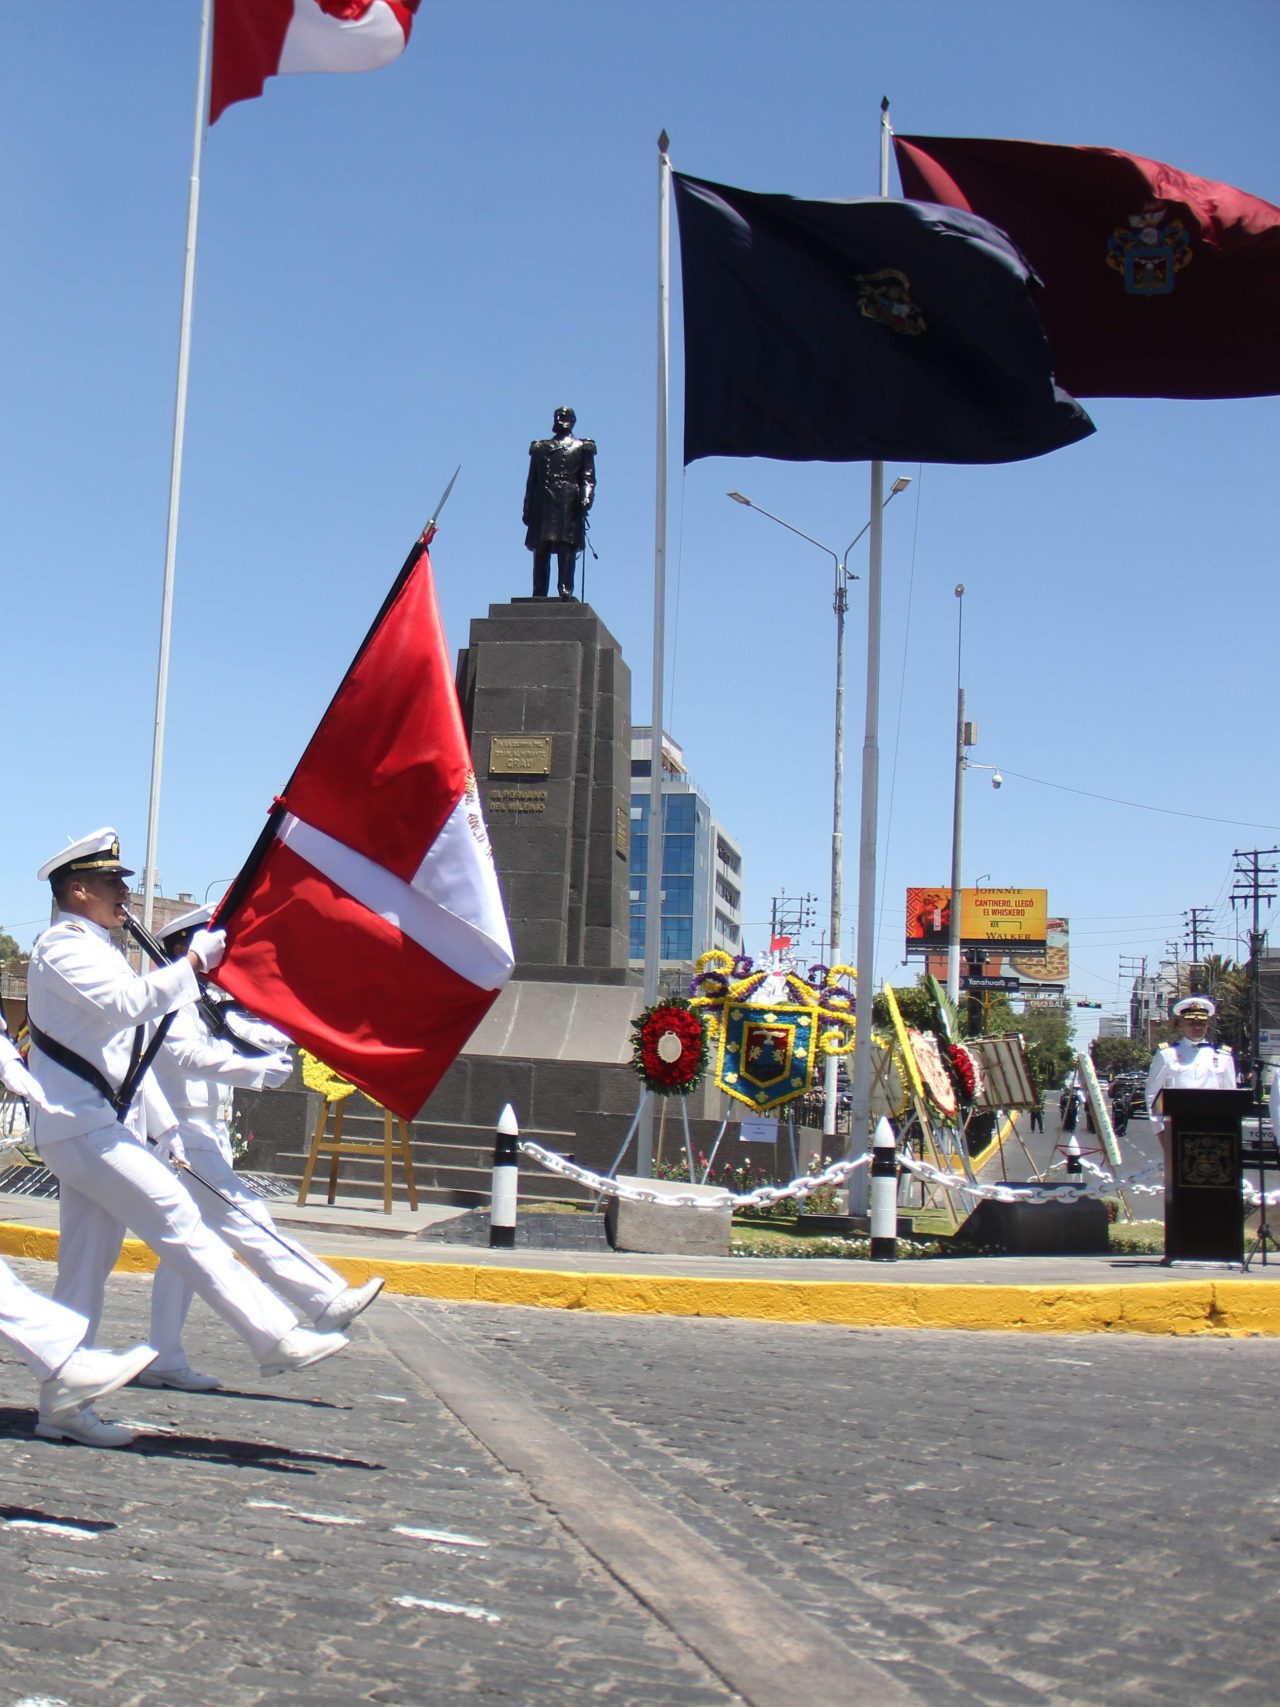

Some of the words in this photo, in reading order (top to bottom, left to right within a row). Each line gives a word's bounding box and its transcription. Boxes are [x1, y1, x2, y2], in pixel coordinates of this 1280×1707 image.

[490, 802, 505, 811] DEL
[974, 888, 1023, 896] JOHNNIE
[975, 899, 1013, 908] CANTINERO,
[1014, 898, 1034, 907] LLEGÓ
[1030, 1000, 1065, 1008] GLOBAL
